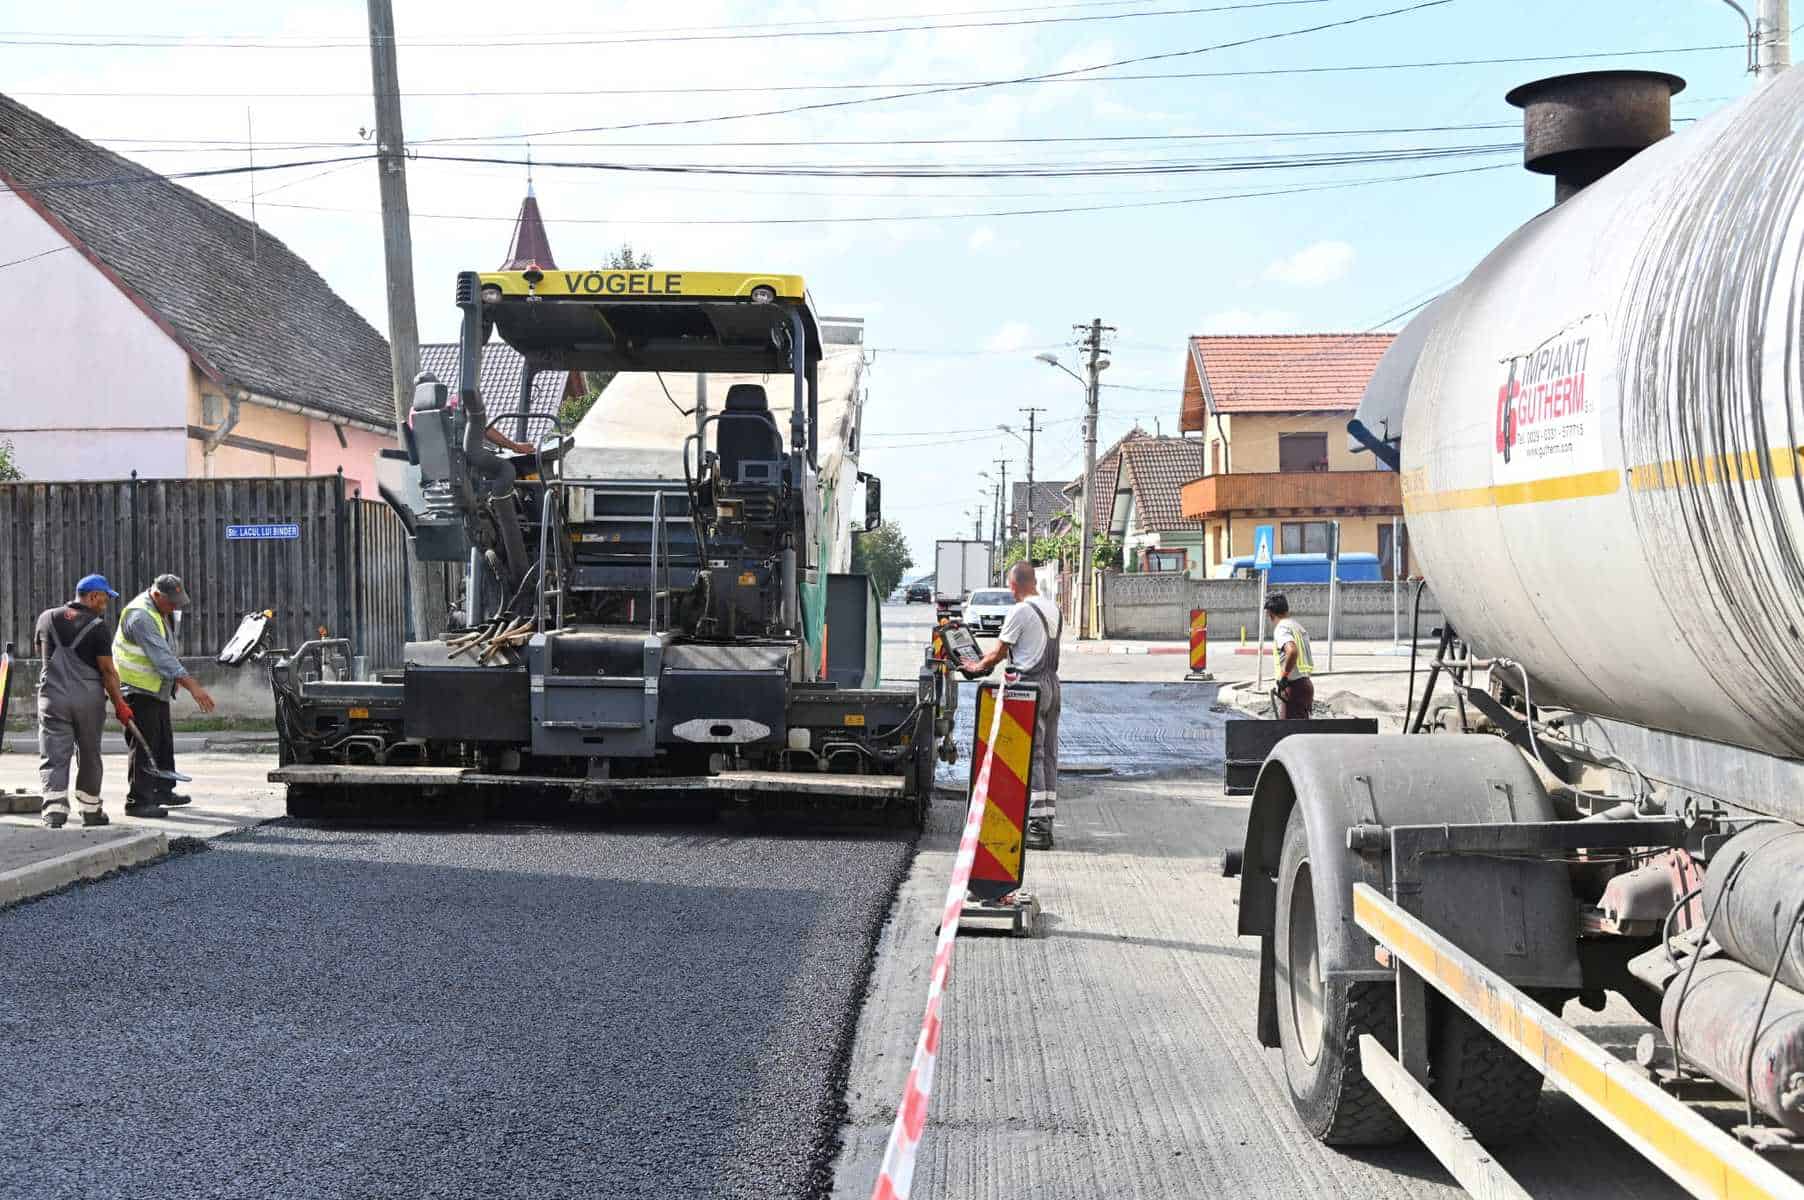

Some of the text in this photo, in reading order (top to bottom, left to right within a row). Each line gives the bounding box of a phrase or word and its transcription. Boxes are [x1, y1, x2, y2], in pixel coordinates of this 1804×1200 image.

[564, 270, 683, 294] VÖGELE
[1521, 336, 1590, 388] IMPIANTI
[1518, 372, 1585, 427] GUTHERM
[240, 527, 260, 537] LACUL
[261, 527, 272, 536] LUI
[273, 526, 297, 536] BINDER
